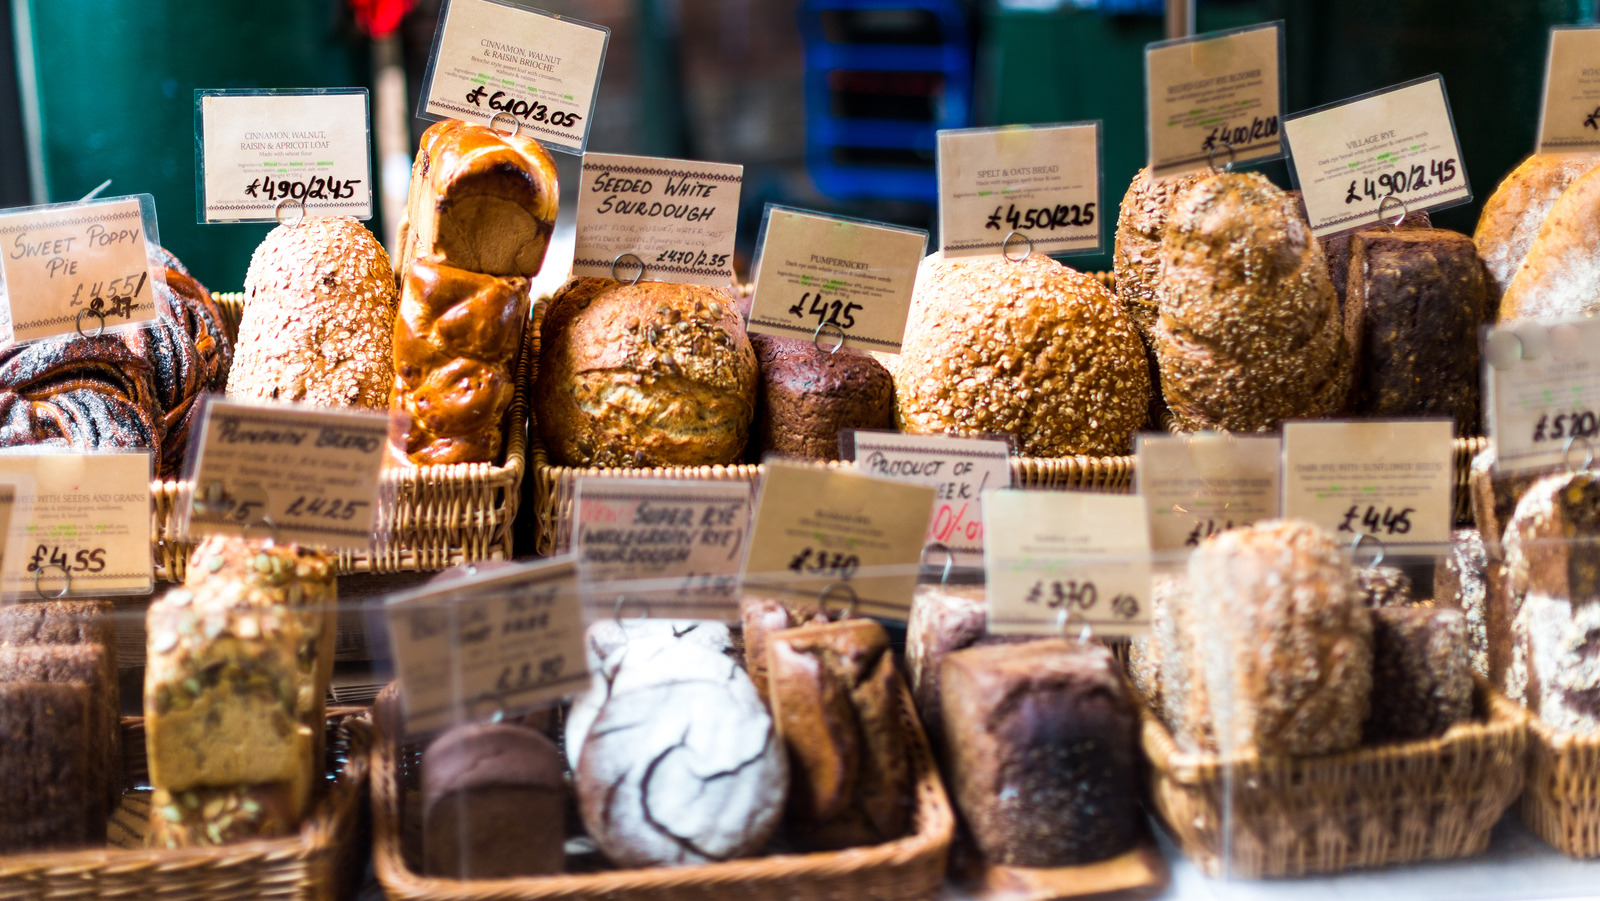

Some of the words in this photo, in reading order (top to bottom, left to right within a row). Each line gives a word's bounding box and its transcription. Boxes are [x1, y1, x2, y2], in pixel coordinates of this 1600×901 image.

[480, 39, 527, 56] CINNAMON,
[528, 51, 561, 64] WALNUT
[492, 51, 518, 63] RAISIN
[519, 57, 554, 72] BRIOCHE
[244, 131, 290, 139] CINNAMON,
[275, 141, 308, 149] APRICOT
[1346, 135, 1379, 149] VILLAGE
[1380, 130, 1396, 139] RYE
[976, 169, 1000, 178] SPELT
[1010, 167, 1030, 175] OATS
[1032, 165, 1059, 174] BREAD
[592, 172, 652, 194] SEEDED
[597, 195, 716, 222] SOURDOUGH
[10, 233, 76, 260] SWEET
[86, 224, 139, 247] POPPY
[810, 254, 869, 272] PUMPERNICKEL
[866, 452, 945, 476] PRODUCT
[953, 462, 973, 476] OF
[937, 471, 989, 501] EEK!
[37, 494, 60, 502] WITH
[62, 494, 89, 502] SEEDS
[92, 494, 111, 502] AND
[113, 494, 144, 502] GRAINS
[634, 500, 694, 526] SUPER
